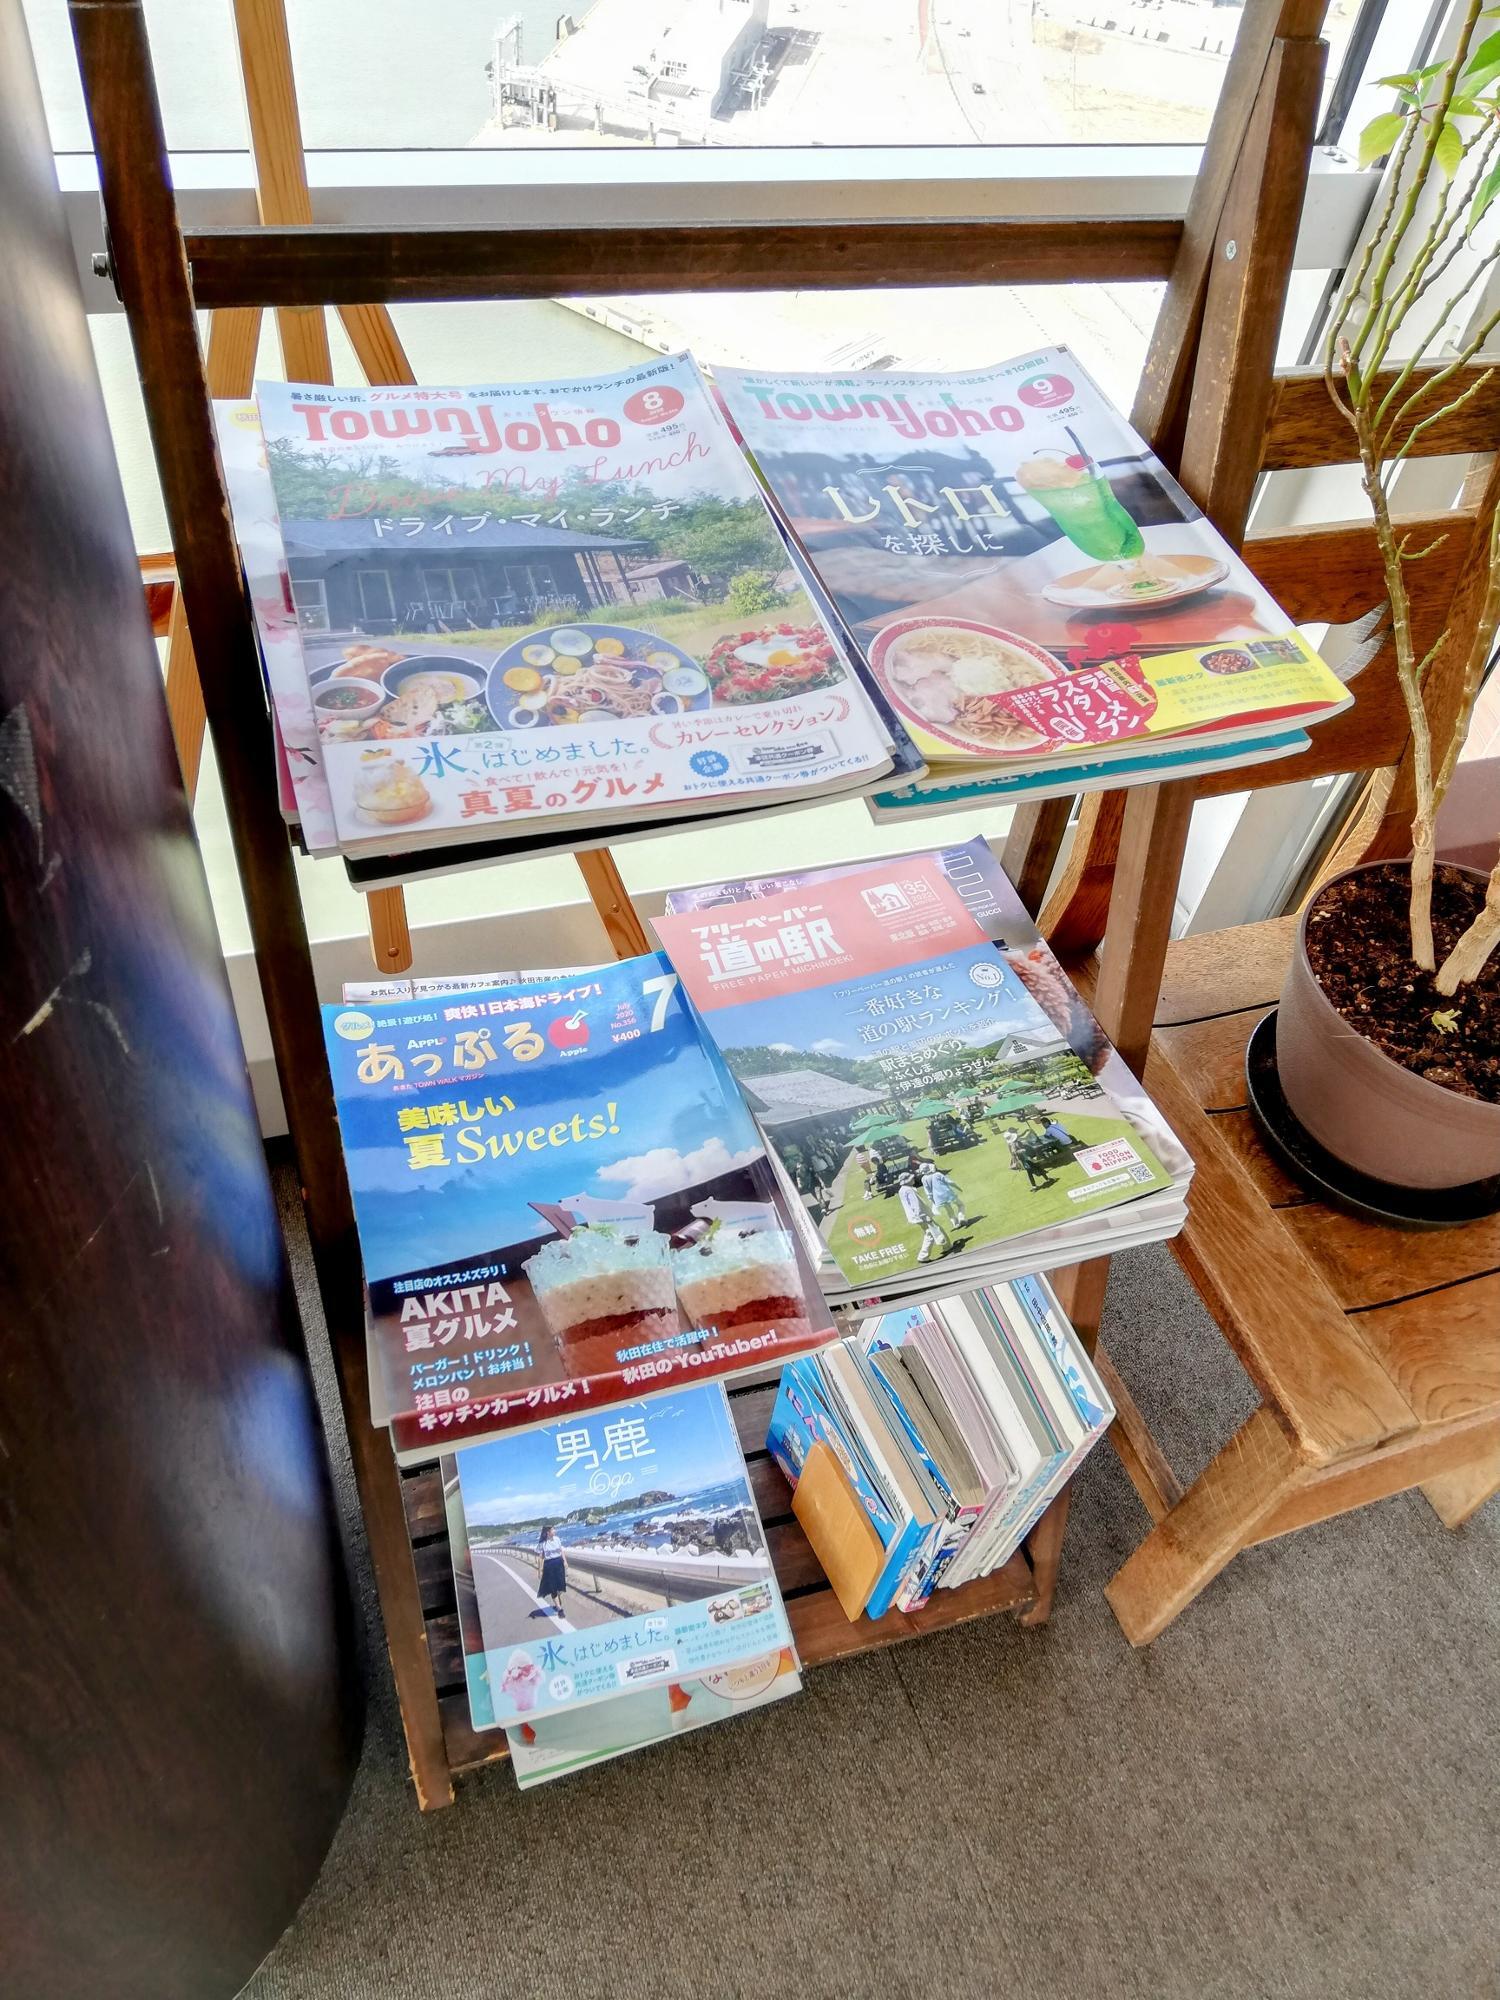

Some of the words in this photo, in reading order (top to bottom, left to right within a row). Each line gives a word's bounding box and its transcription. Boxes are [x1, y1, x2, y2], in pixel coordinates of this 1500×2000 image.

[641, 391, 664, 410] 8
[1032, 378, 1053, 395] 9
[580, 431, 711, 486] Lunch
[372, 500, 681, 538] ドライブ・マイ・ランチ
[822, 484, 1012, 529] レトロ
[880, 533, 1004, 556] を探しに
[676, 707, 835, 746] カレーセレクション
[457, 773, 665, 819] 真夏のグルメ
[691, 904, 824, 940] フリーペーパー
[976, 907, 1002, 918] GUCCI
[700, 917, 845, 983] 道の駅
[712, 978, 745, 993] FREE
[749, 968, 789, 986] PAPER
[792, 954, 855, 976] MICHINOEKI
[615, 1009, 635, 1021] 2020
[616, 1002, 631, 1012] July
[642, 972, 678, 1033] 7
[845, 983, 944, 1017] 一番好きな
[356, 1021, 545, 1085] あっぷる
[559, 1046, 589, 1058] Apple
[611, 1029, 641, 1044] ¥400
[879, 1039, 963, 1073] 駅まちめぐり
[414, 1079, 437, 1090] TOWN
[437, 1076, 459, 1087] WALK
[397, 1095, 517, 1132] 美味しい
[403, 1132, 452, 1171] 夏
[456, 1102, 622, 1164] Sweets!
[1098, 1148, 1119, 1160] FOOD
[1104, 1154, 1134, 1168] NIPPON
[851, 1251, 879, 1265] TAKE
[879, 1243, 907, 1258] FREE
[400, 1282, 512, 1323] AKITA
[402, 1307, 519, 1352] 夏グルメ
[415, 1387, 470, 1411] 注目の
[555, 1418, 656, 1477] 男鹿
[587, 1469, 635, 1498] Oga
